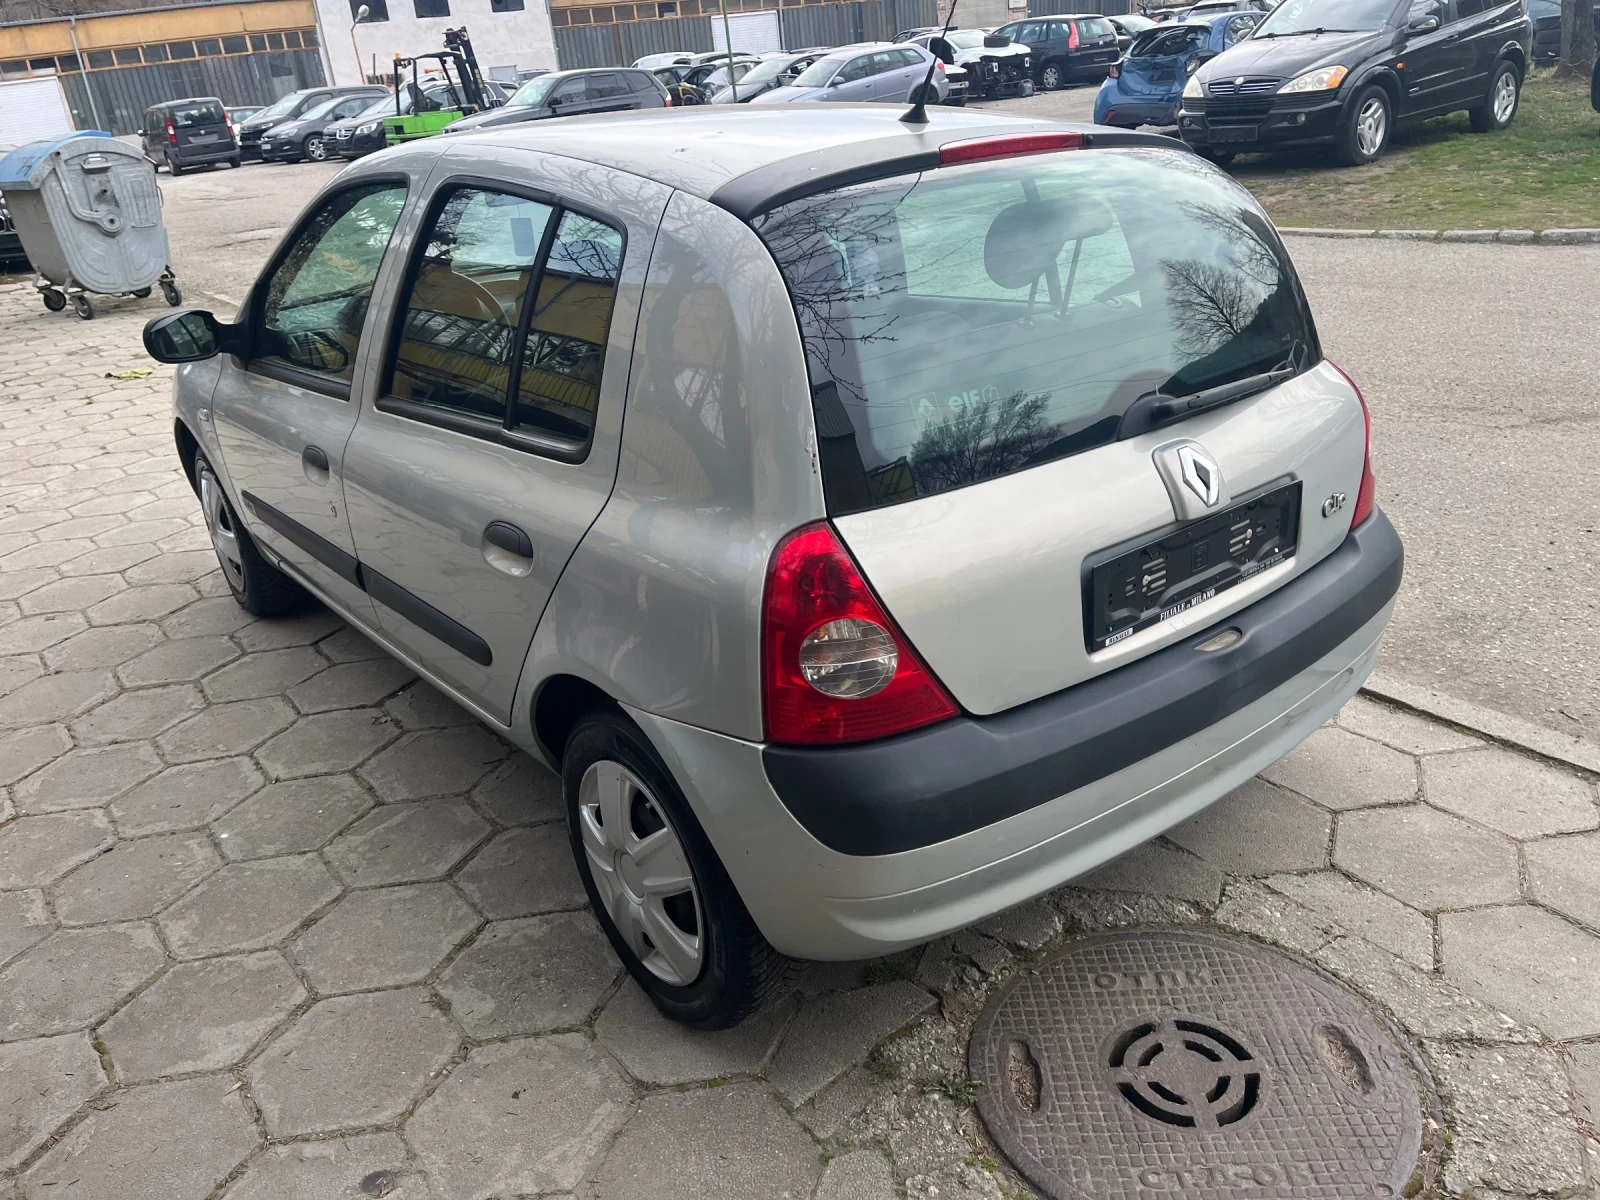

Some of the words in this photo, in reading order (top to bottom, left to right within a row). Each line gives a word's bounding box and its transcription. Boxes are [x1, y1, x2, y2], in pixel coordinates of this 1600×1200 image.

[948, 389, 980, 412] elf
[1160, 602, 1185, 621] FILIALE
[1191, 588, 1216, 607] MILANO
